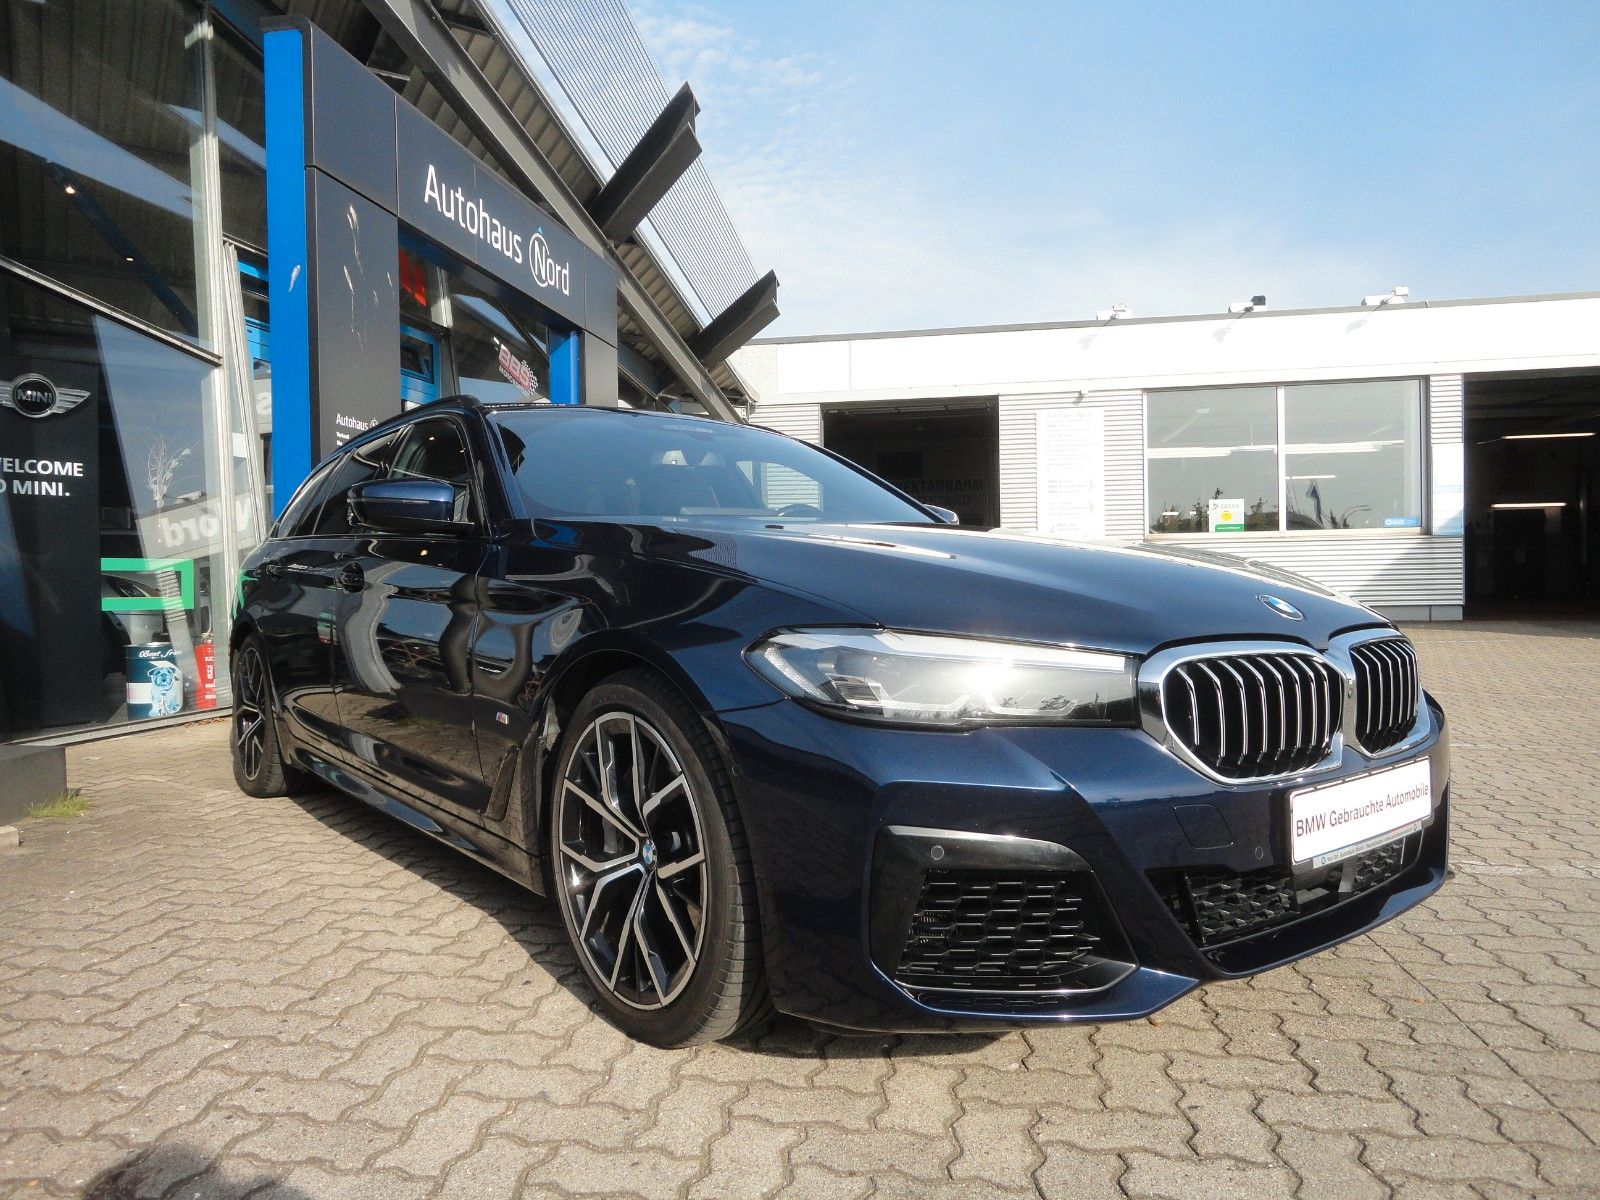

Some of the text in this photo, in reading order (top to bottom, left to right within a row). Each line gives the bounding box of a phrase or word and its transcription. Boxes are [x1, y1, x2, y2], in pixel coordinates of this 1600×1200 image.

[424, 164, 570, 296] Autohaus Nord
[17, 388, 53, 403] MINI
[336, 413, 369, 431] Autohaus
[0, 457, 84, 477] ELCOME
[13, 480, 71, 497] MINI.
[1296, 783, 1429, 837] BMW Gebrauchte Automobile
